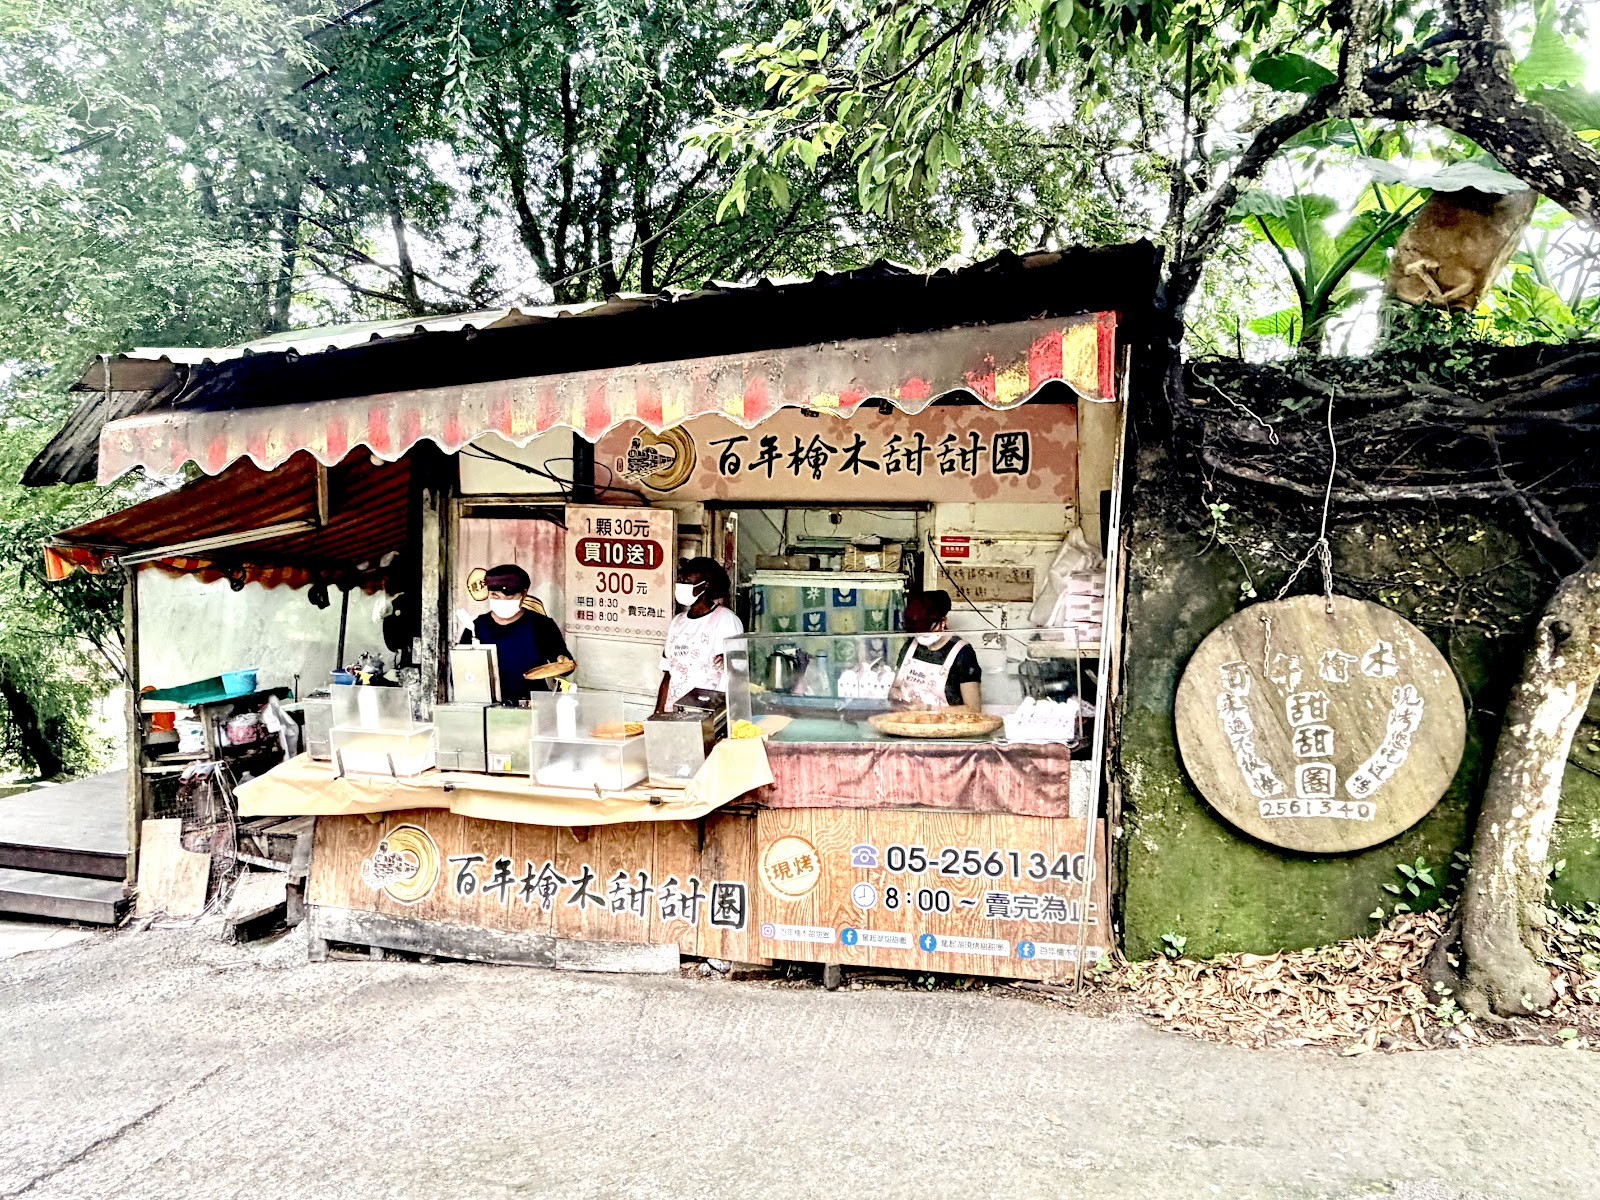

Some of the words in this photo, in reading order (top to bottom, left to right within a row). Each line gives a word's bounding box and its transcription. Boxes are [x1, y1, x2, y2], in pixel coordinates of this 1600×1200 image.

[709, 430, 1030, 481] 百年檜木甜甜圈
[584, 541, 654, 566] 買10送1
[599, 598, 618, 608] 8:30
[599, 612, 618, 622] 8:00
[1262, 801, 1371, 818] 2561340
[771, 855, 814, 881] 現烤
[887, 846, 1095, 882] 05-2561340
[448, 854, 747, 930] 百年檜木甜甜圈
